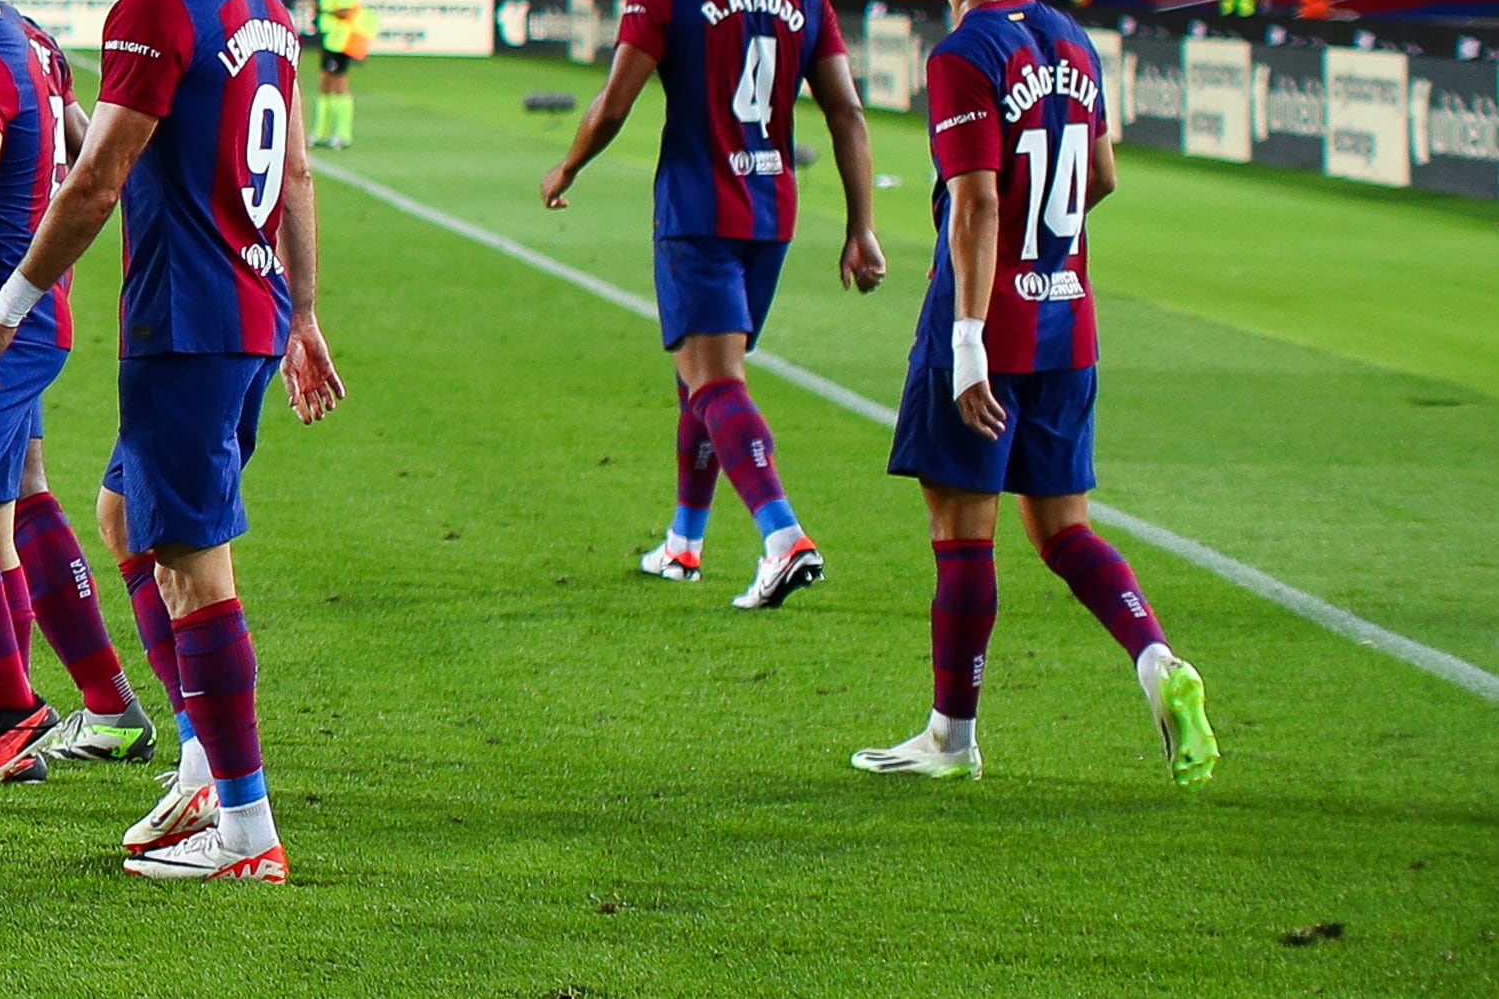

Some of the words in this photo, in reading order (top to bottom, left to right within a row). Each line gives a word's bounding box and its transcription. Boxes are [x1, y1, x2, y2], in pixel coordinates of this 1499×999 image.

[732, 34, 778, 139] 4
[240, 83, 288, 230] 9
[1015, 123, 1089, 261] 14
